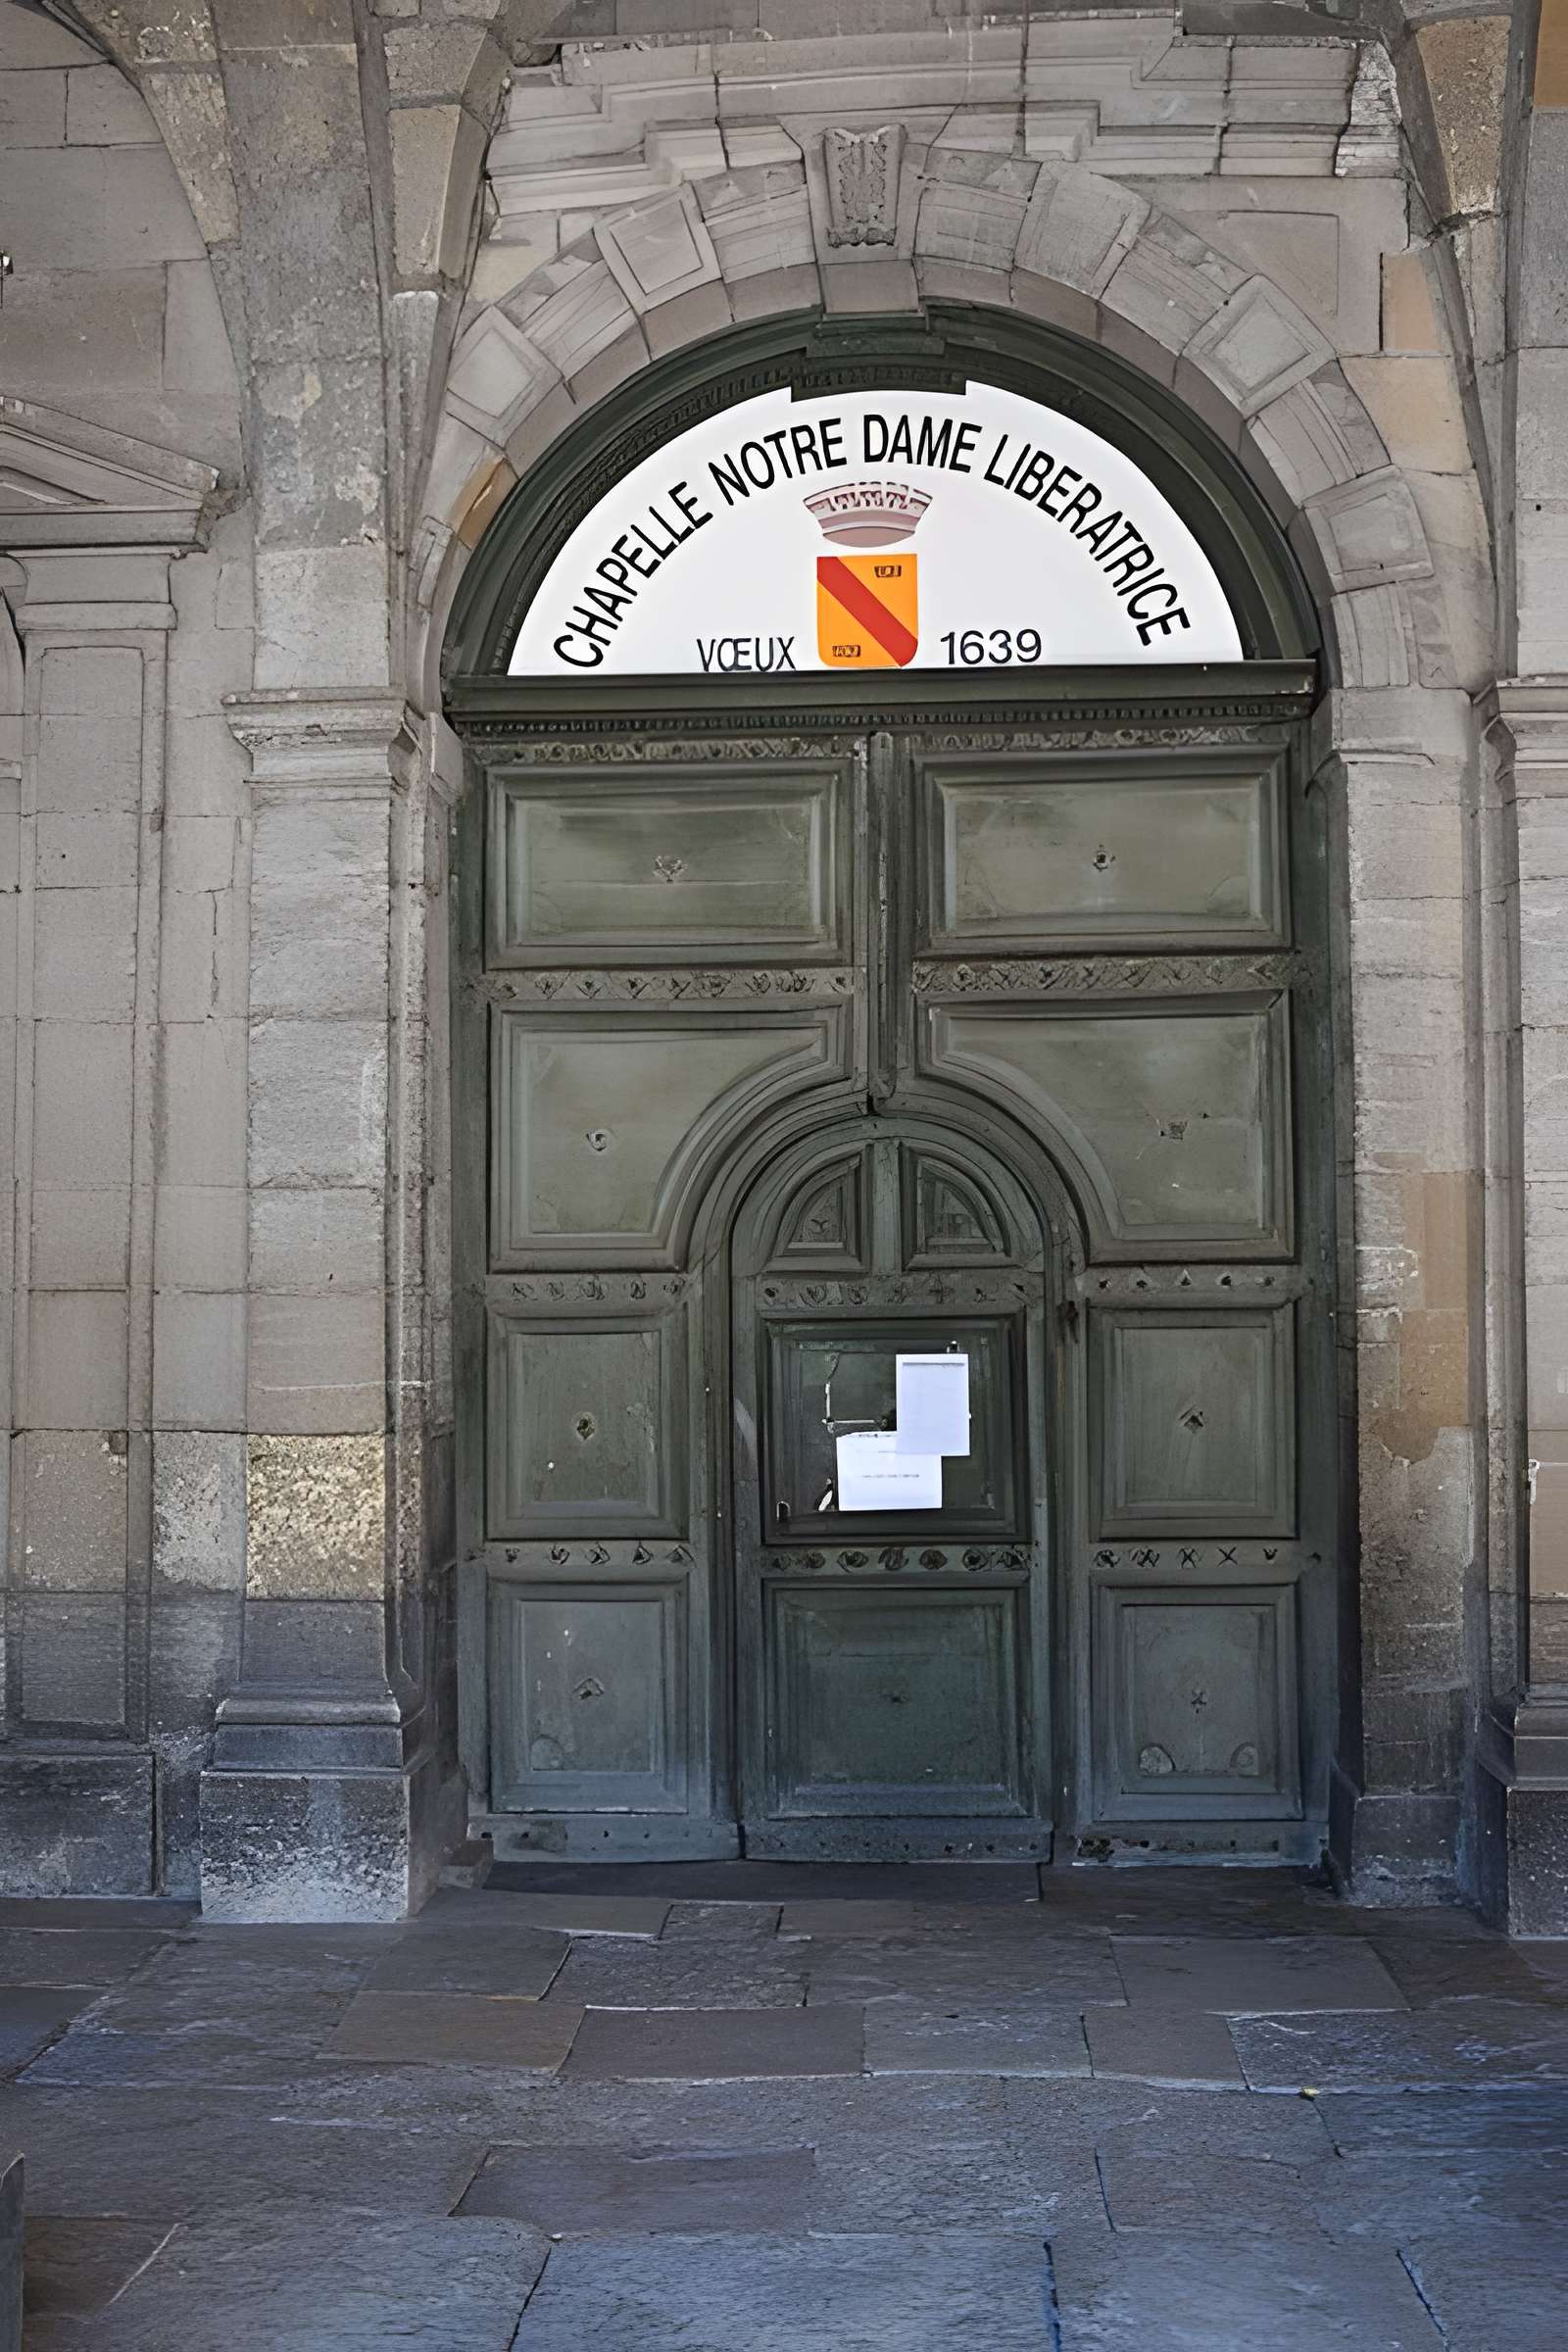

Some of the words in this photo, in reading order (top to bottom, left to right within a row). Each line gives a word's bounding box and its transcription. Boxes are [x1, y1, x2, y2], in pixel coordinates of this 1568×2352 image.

[553, 480, 714, 668] CHAPELLE
[708, 416, 848, 507] NOTRE
[862, 414, 983, 473] DAME
[983, 433, 1192, 647] LIBERATRICE
[696, 636, 796, 672] VŒUX
[940, 628, 1042, 665] 1639
